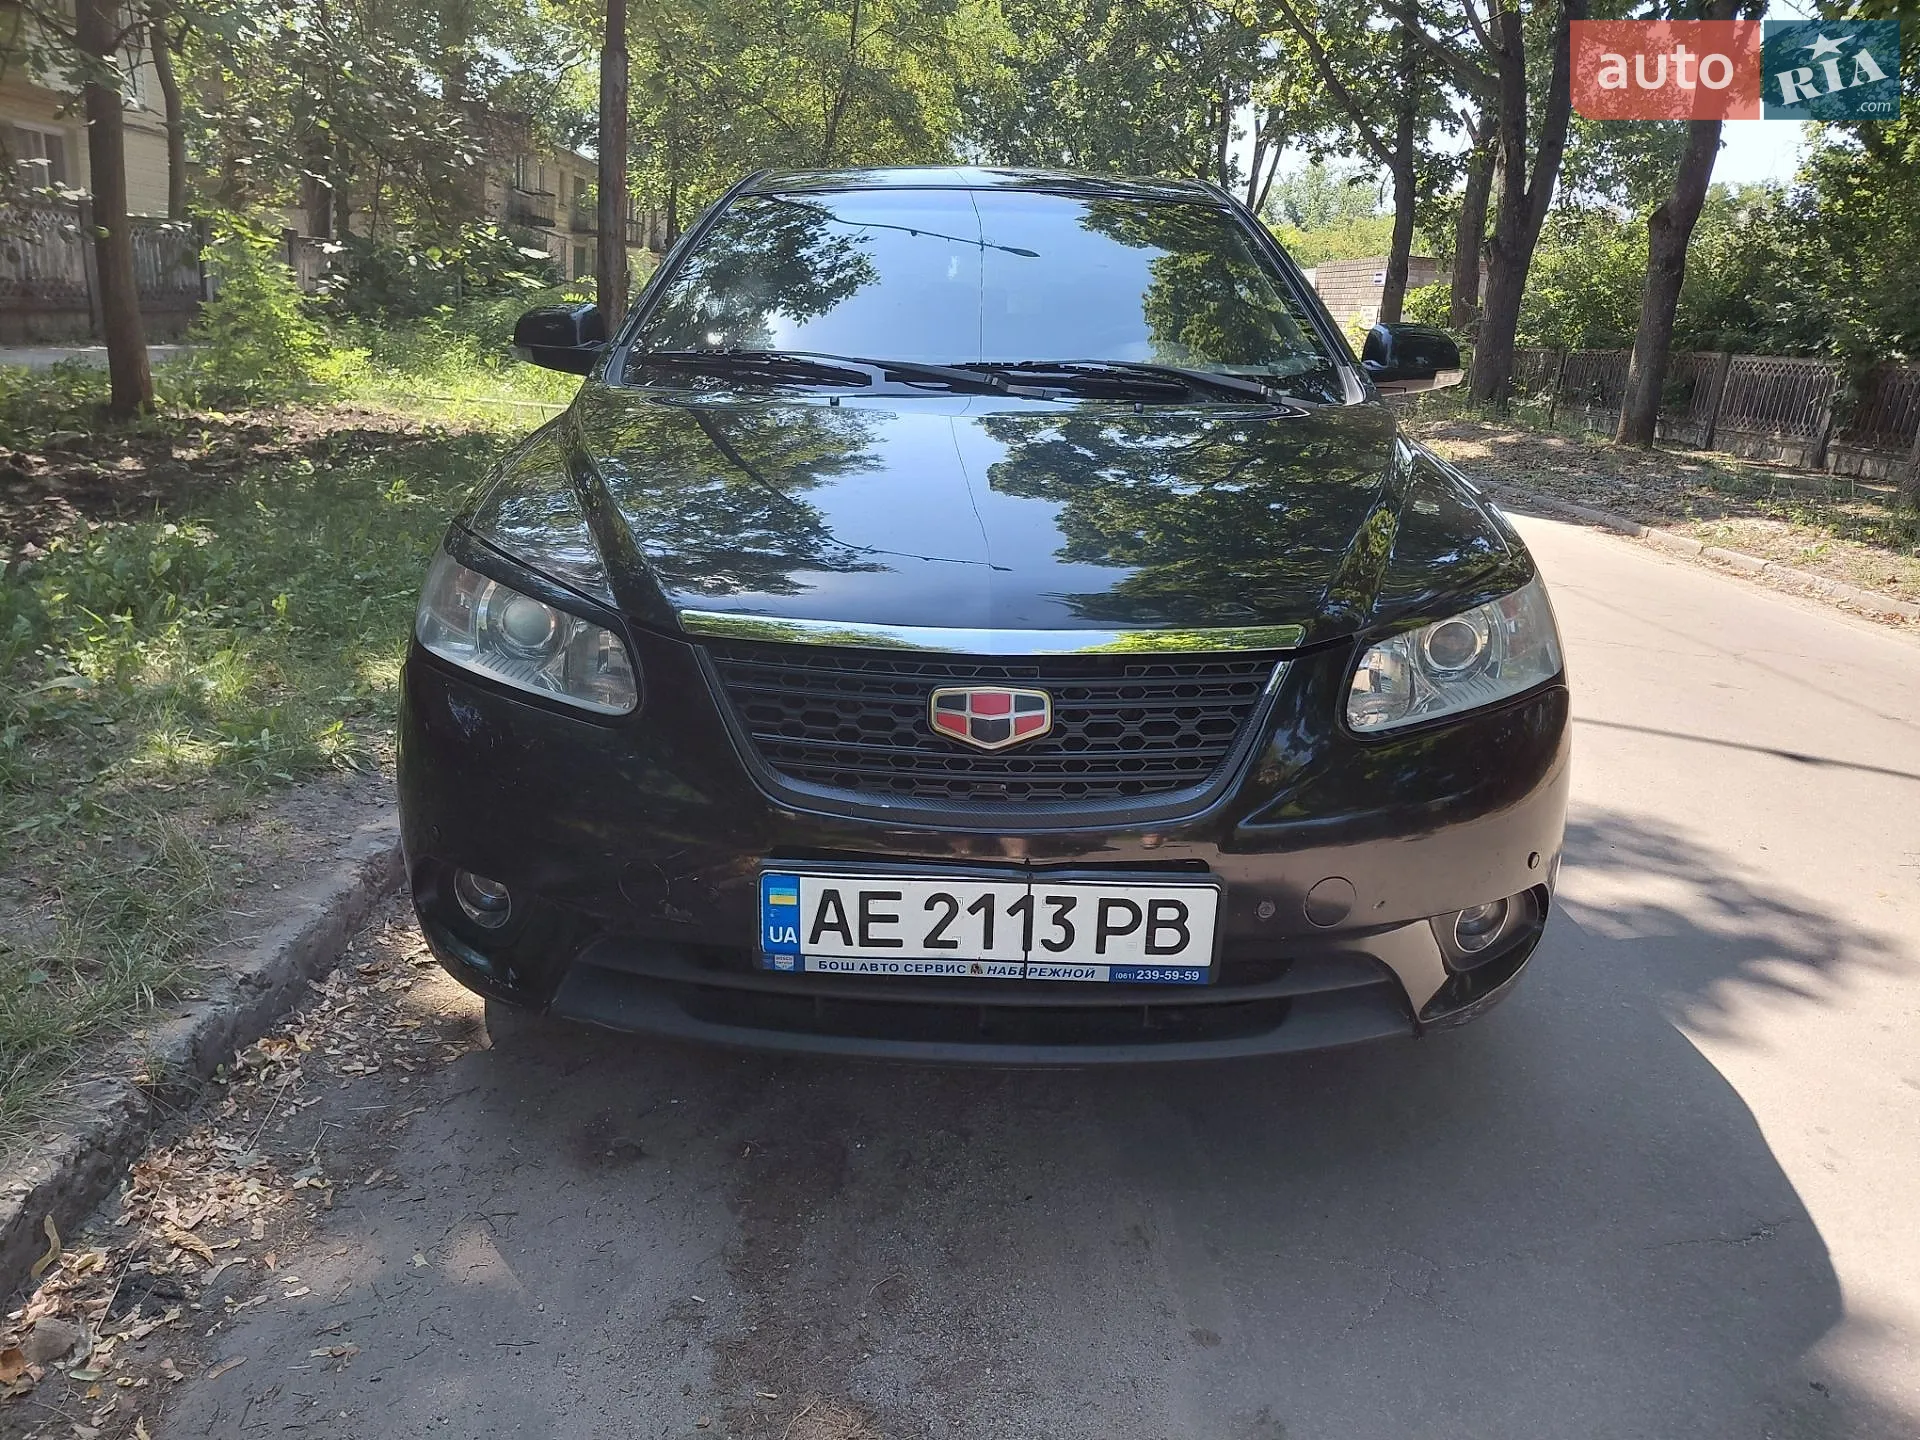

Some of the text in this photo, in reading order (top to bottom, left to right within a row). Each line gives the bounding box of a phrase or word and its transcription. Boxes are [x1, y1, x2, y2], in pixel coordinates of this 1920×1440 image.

[808, 888, 904, 949] AE
[923, 893, 1076, 953] 2113
[769, 926, 798, 944] UA
[818, 960, 855, 971] БОШ
[858, 962, 899, 973] АВТО
[903, 963, 967, 975] СЕРВИС
[1136, 969, 1200, 982] 239-59-59
